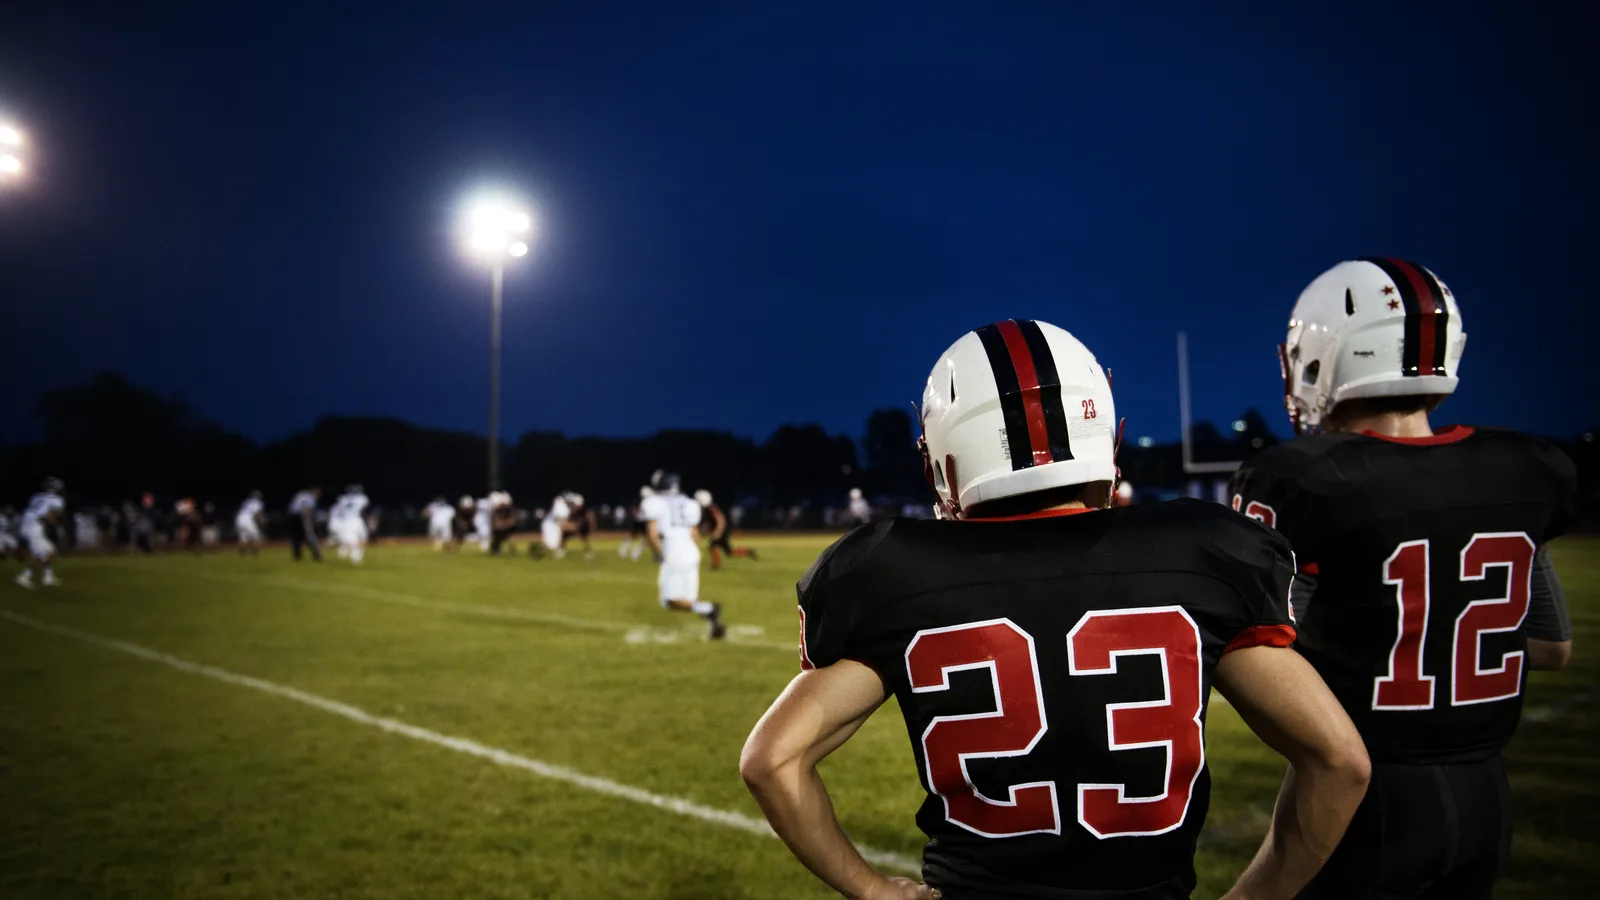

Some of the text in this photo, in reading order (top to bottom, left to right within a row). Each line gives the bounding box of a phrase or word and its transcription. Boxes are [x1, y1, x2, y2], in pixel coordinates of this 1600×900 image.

[1081, 399, 1097, 419] 23
[1372, 531, 1536, 710] 12
[905, 605, 1205, 839] 23
